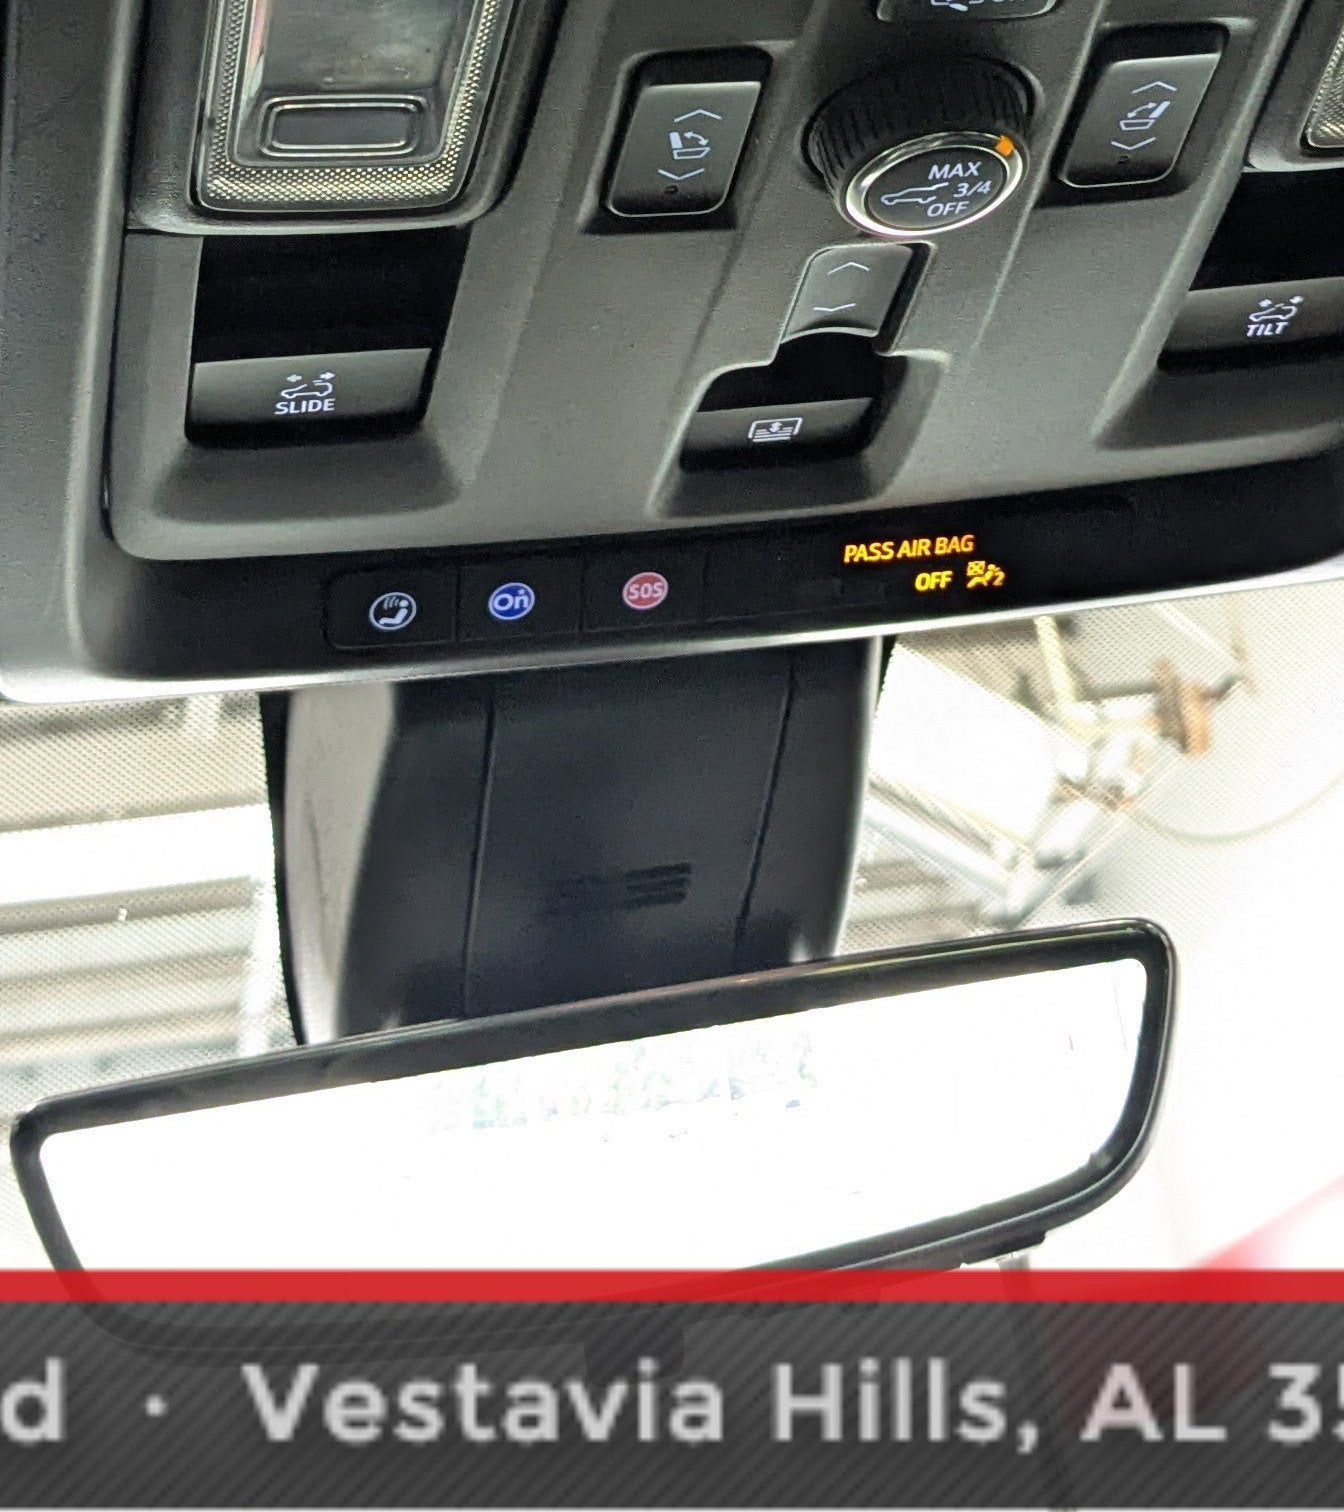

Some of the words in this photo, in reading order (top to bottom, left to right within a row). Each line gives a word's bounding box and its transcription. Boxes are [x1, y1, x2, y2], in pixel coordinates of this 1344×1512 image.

[927, 160, 982, 180] MAX
[953, 180, 992, 198] 3/4
[926, 200, 970, 218] OFF
[1246, 321, 1290, 337] TILT
[273, 398, 336, 415] SLIDE
[843, 541, 895, 564] PASS
[896, 538, 931, 559] AIR
[934, 534, 975, 555] BAG
[914, 570, 953, 592] OFF
[627, 582, 664, 601] SOS
